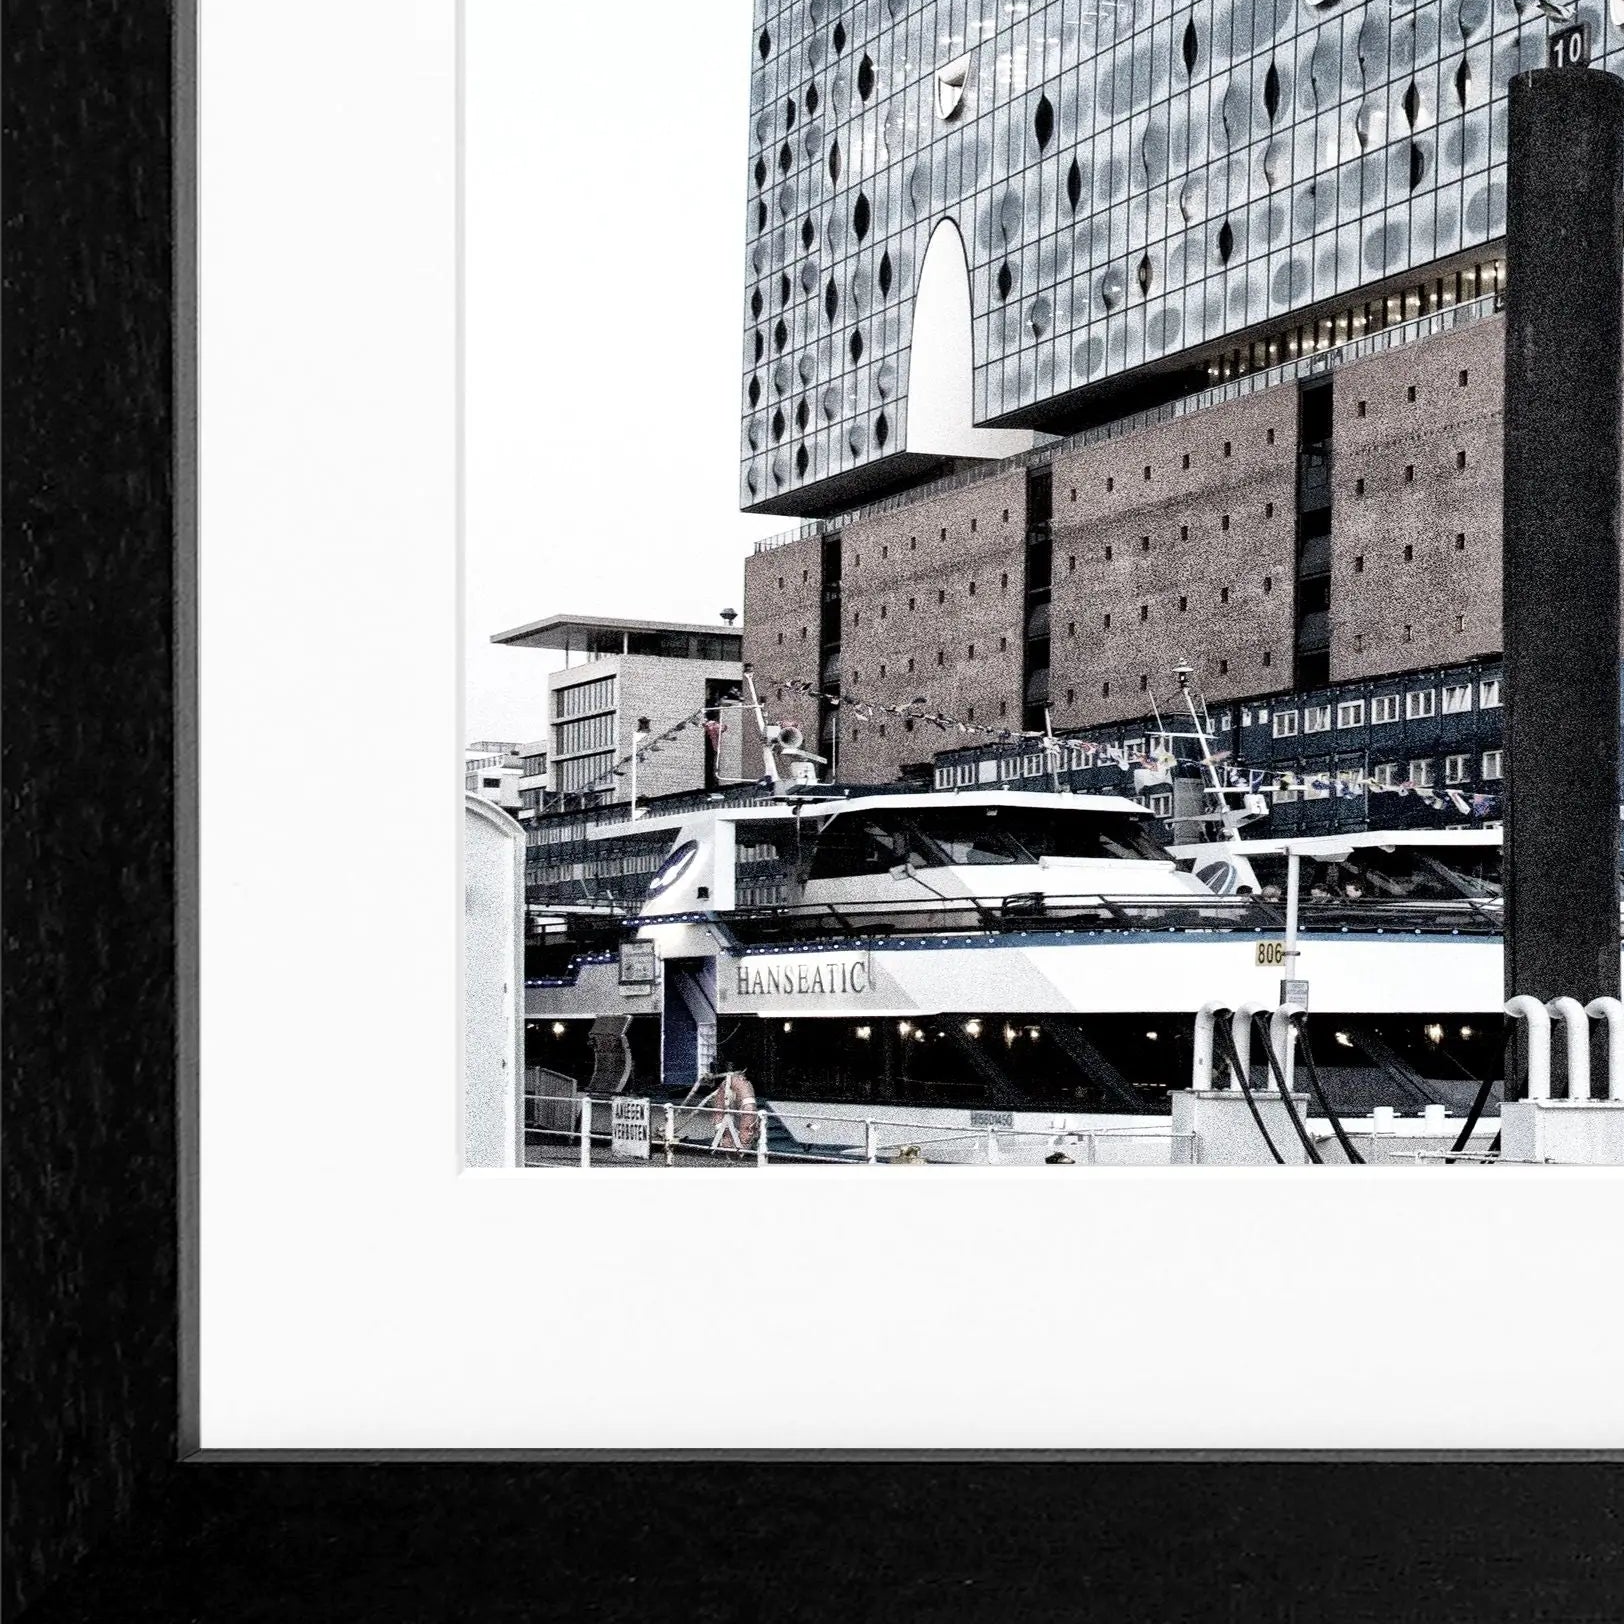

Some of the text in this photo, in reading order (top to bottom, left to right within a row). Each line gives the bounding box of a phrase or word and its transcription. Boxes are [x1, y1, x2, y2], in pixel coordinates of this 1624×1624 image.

[1553, 32, 1582, 68] 10
[1257, 942, 1283, 964] 806
[736, 961, 867, 995] HANSEATIC
